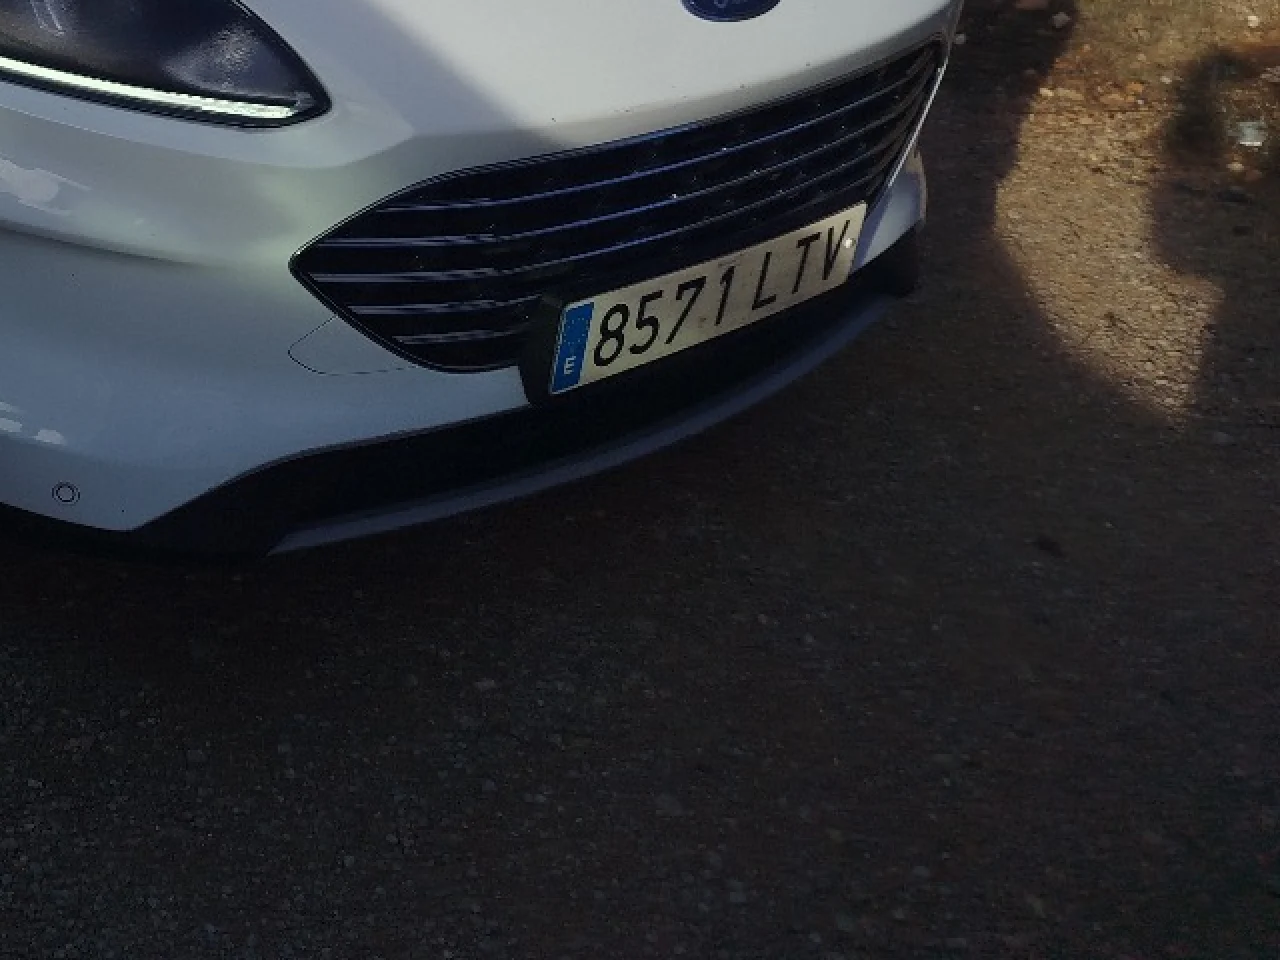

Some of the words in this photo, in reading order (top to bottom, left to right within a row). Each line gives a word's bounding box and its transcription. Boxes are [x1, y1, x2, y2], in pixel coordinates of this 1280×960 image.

[563, 356, 577, 375] E
[593, 265, 736, 367] 8571
[751, 219, 851, 311] LTV
